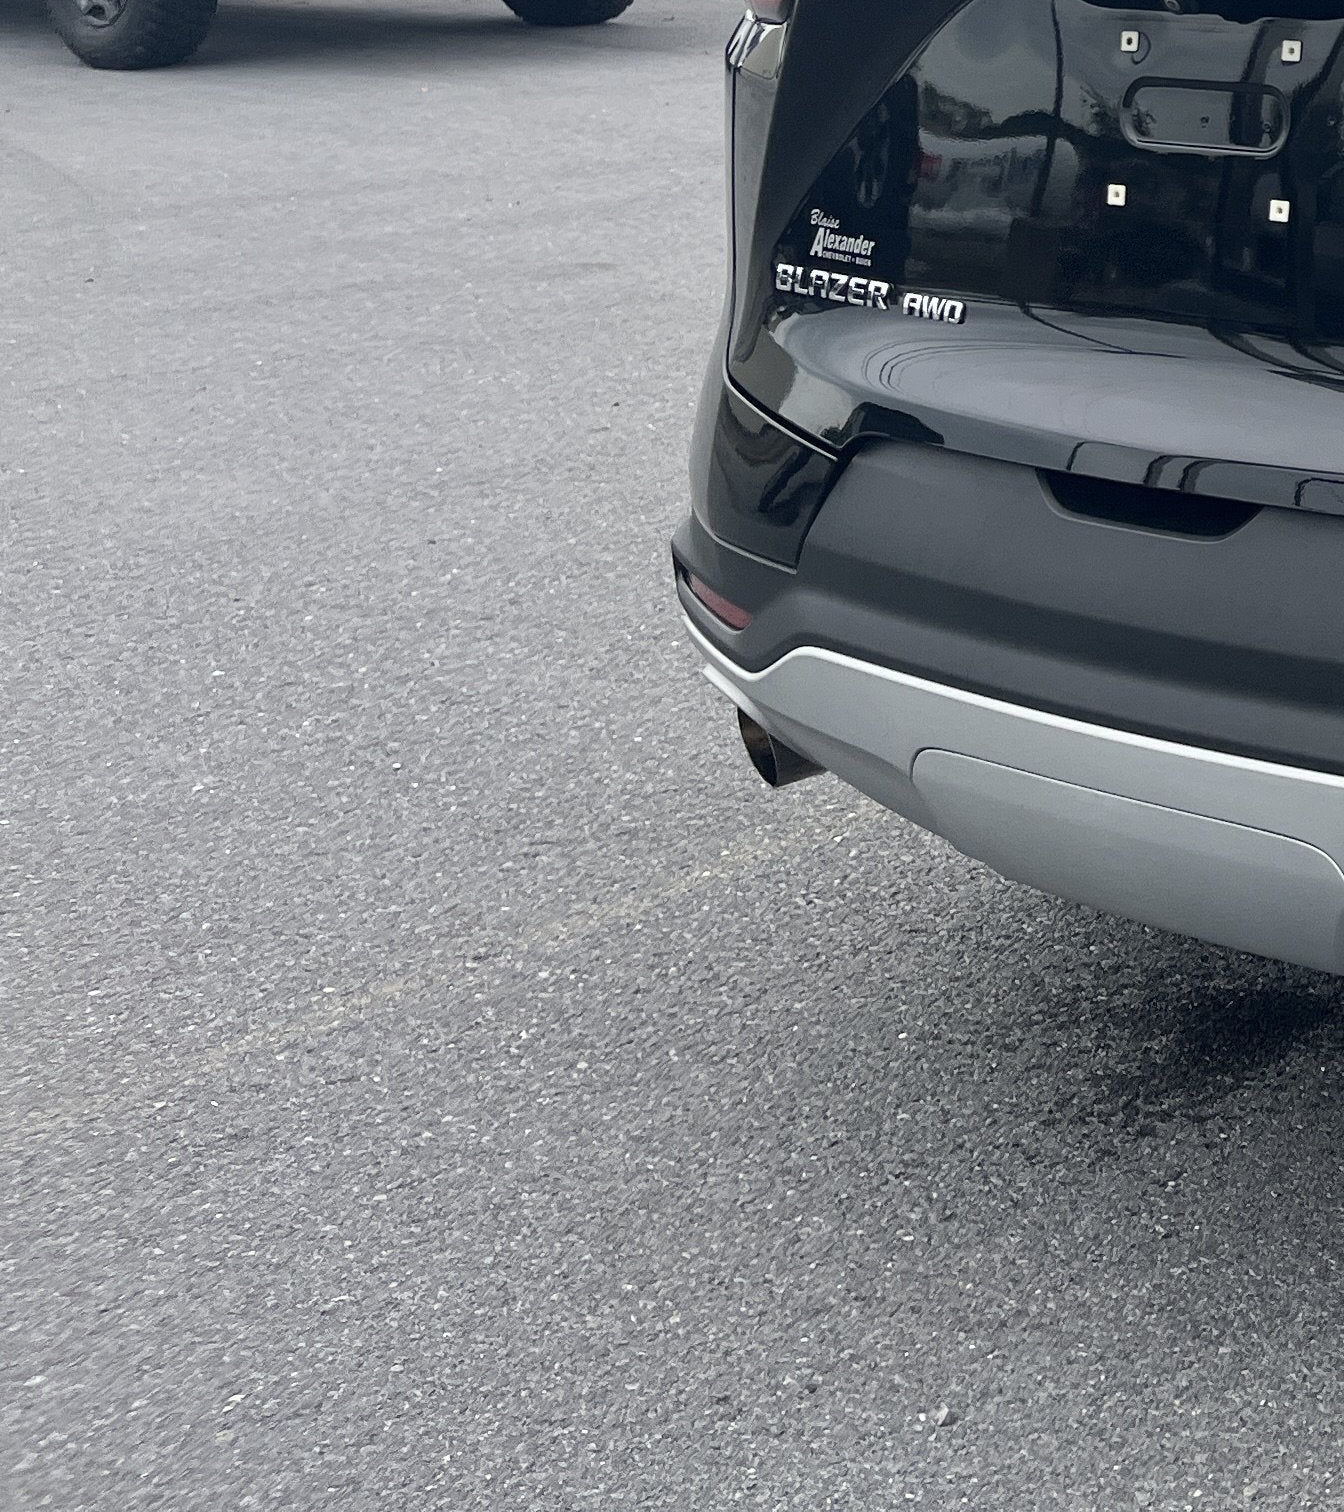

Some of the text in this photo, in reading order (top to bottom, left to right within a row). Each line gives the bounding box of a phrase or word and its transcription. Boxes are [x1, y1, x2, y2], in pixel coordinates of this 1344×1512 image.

[810, 208, 840, 228] Blaise
[809, 227, 876, 257] Alexander
[776, 263, 966, 324] BLAZER AWD
